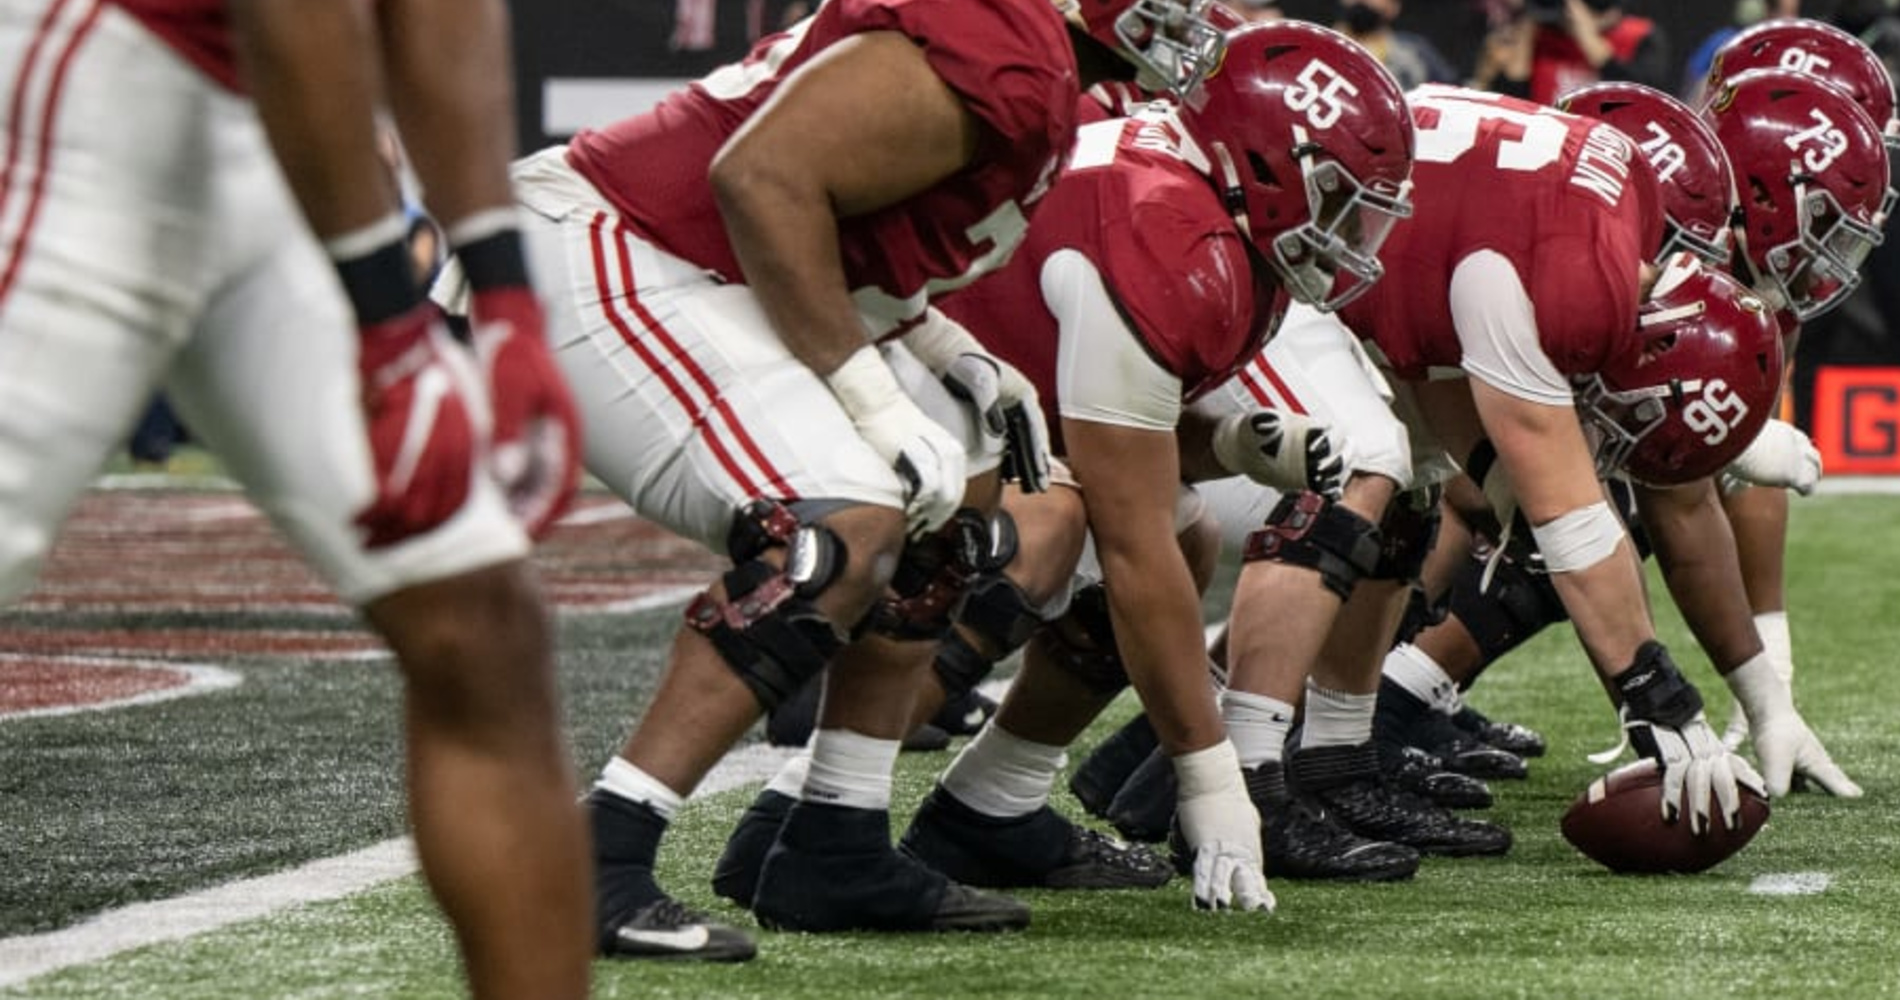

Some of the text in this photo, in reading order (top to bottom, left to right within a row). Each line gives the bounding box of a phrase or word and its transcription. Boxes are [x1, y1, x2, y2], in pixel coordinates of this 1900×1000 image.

[1283, 58, 1358, 129] 55
[1784, 108, 1848, 172] 73
[1844, 386, 1898, 458] G
